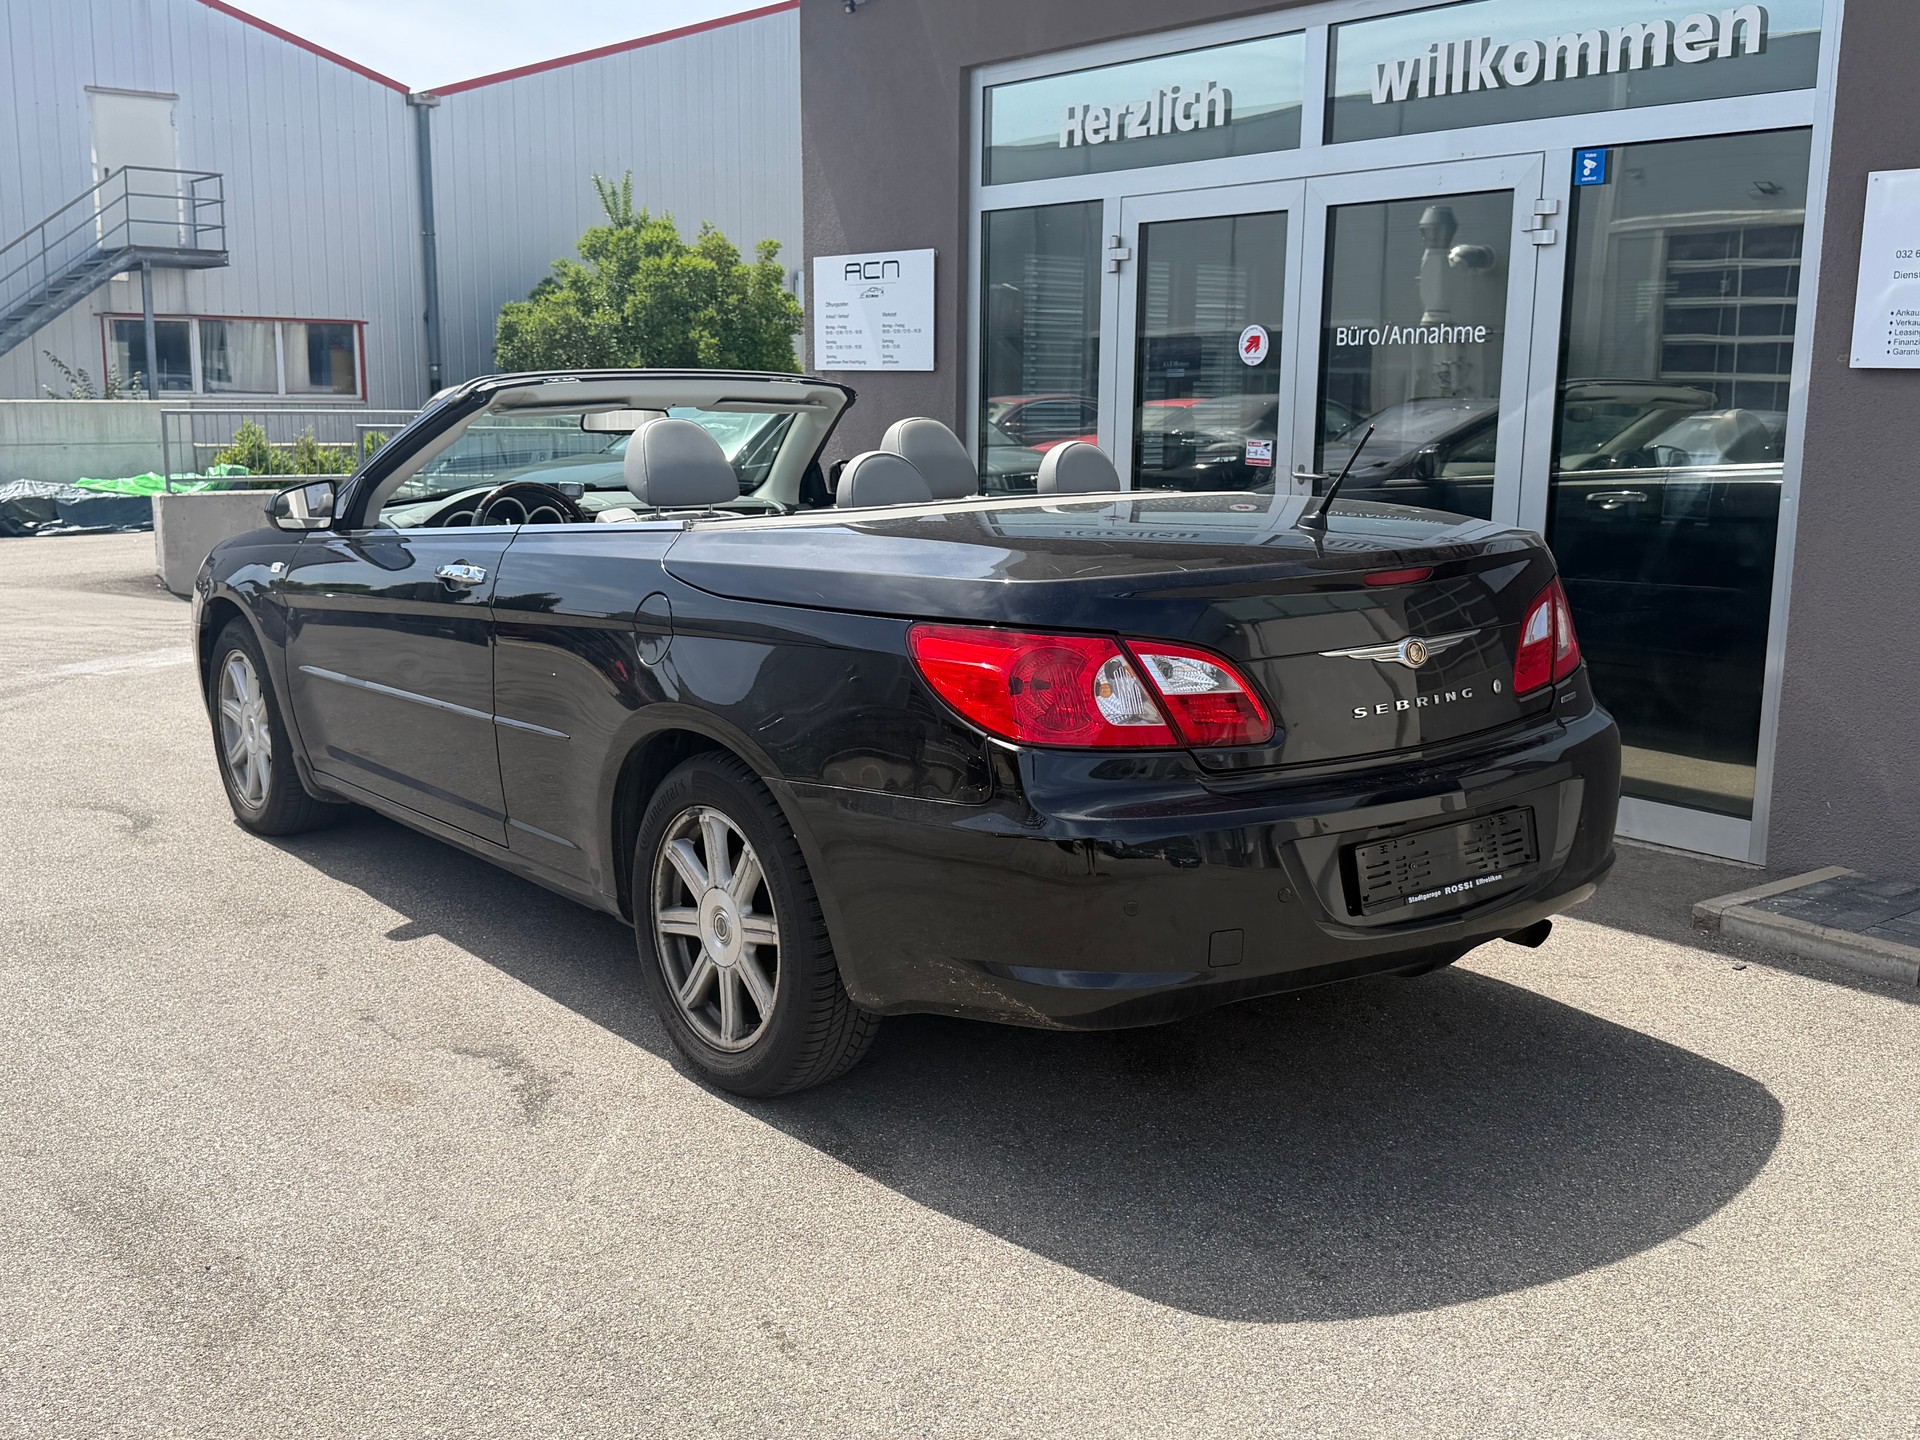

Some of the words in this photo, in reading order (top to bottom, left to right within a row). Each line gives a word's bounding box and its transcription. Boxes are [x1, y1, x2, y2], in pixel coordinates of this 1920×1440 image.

[1059, 80, 1230, 148] Herzlich
[1372, 4, 1764, 104] willkommen
[1895, 249, 1913, 259] 032
[844, 260, 900, 281] ACN
[1336, 324, 1486, 346] Büro/Annahme
[1353, 688, 1473, 719] SEBRING
[1408, 890, 1442, 904] Stadtgarage
[1444, 880, 1474, 895] ROSSI
